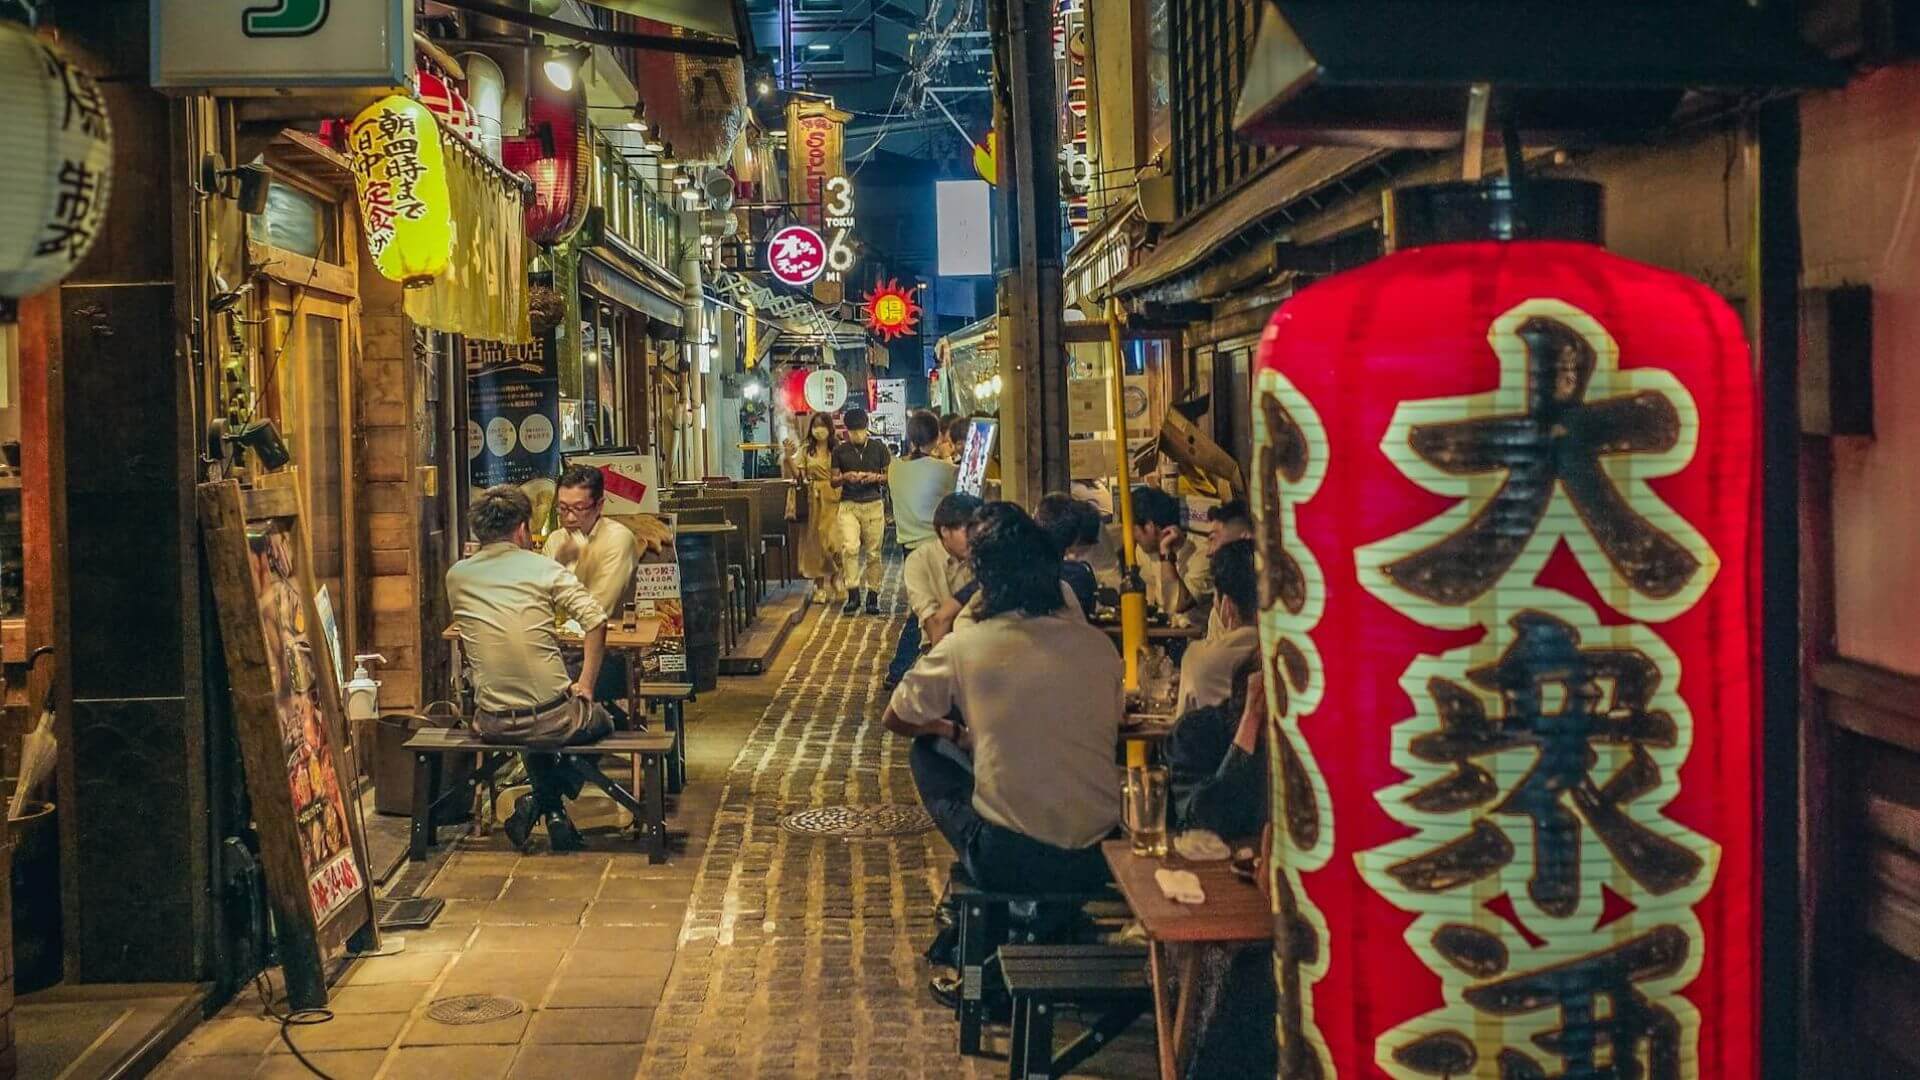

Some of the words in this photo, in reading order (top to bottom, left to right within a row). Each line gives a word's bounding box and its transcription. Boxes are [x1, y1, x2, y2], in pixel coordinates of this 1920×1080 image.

[376, 109, 427, 219] 朝四時まで
[826, 176, 853, 217] 3
[825, 218, 855, 228] TOKU
[829, 228, 853, 271] 6
[826, 272, 841, 282] MI
